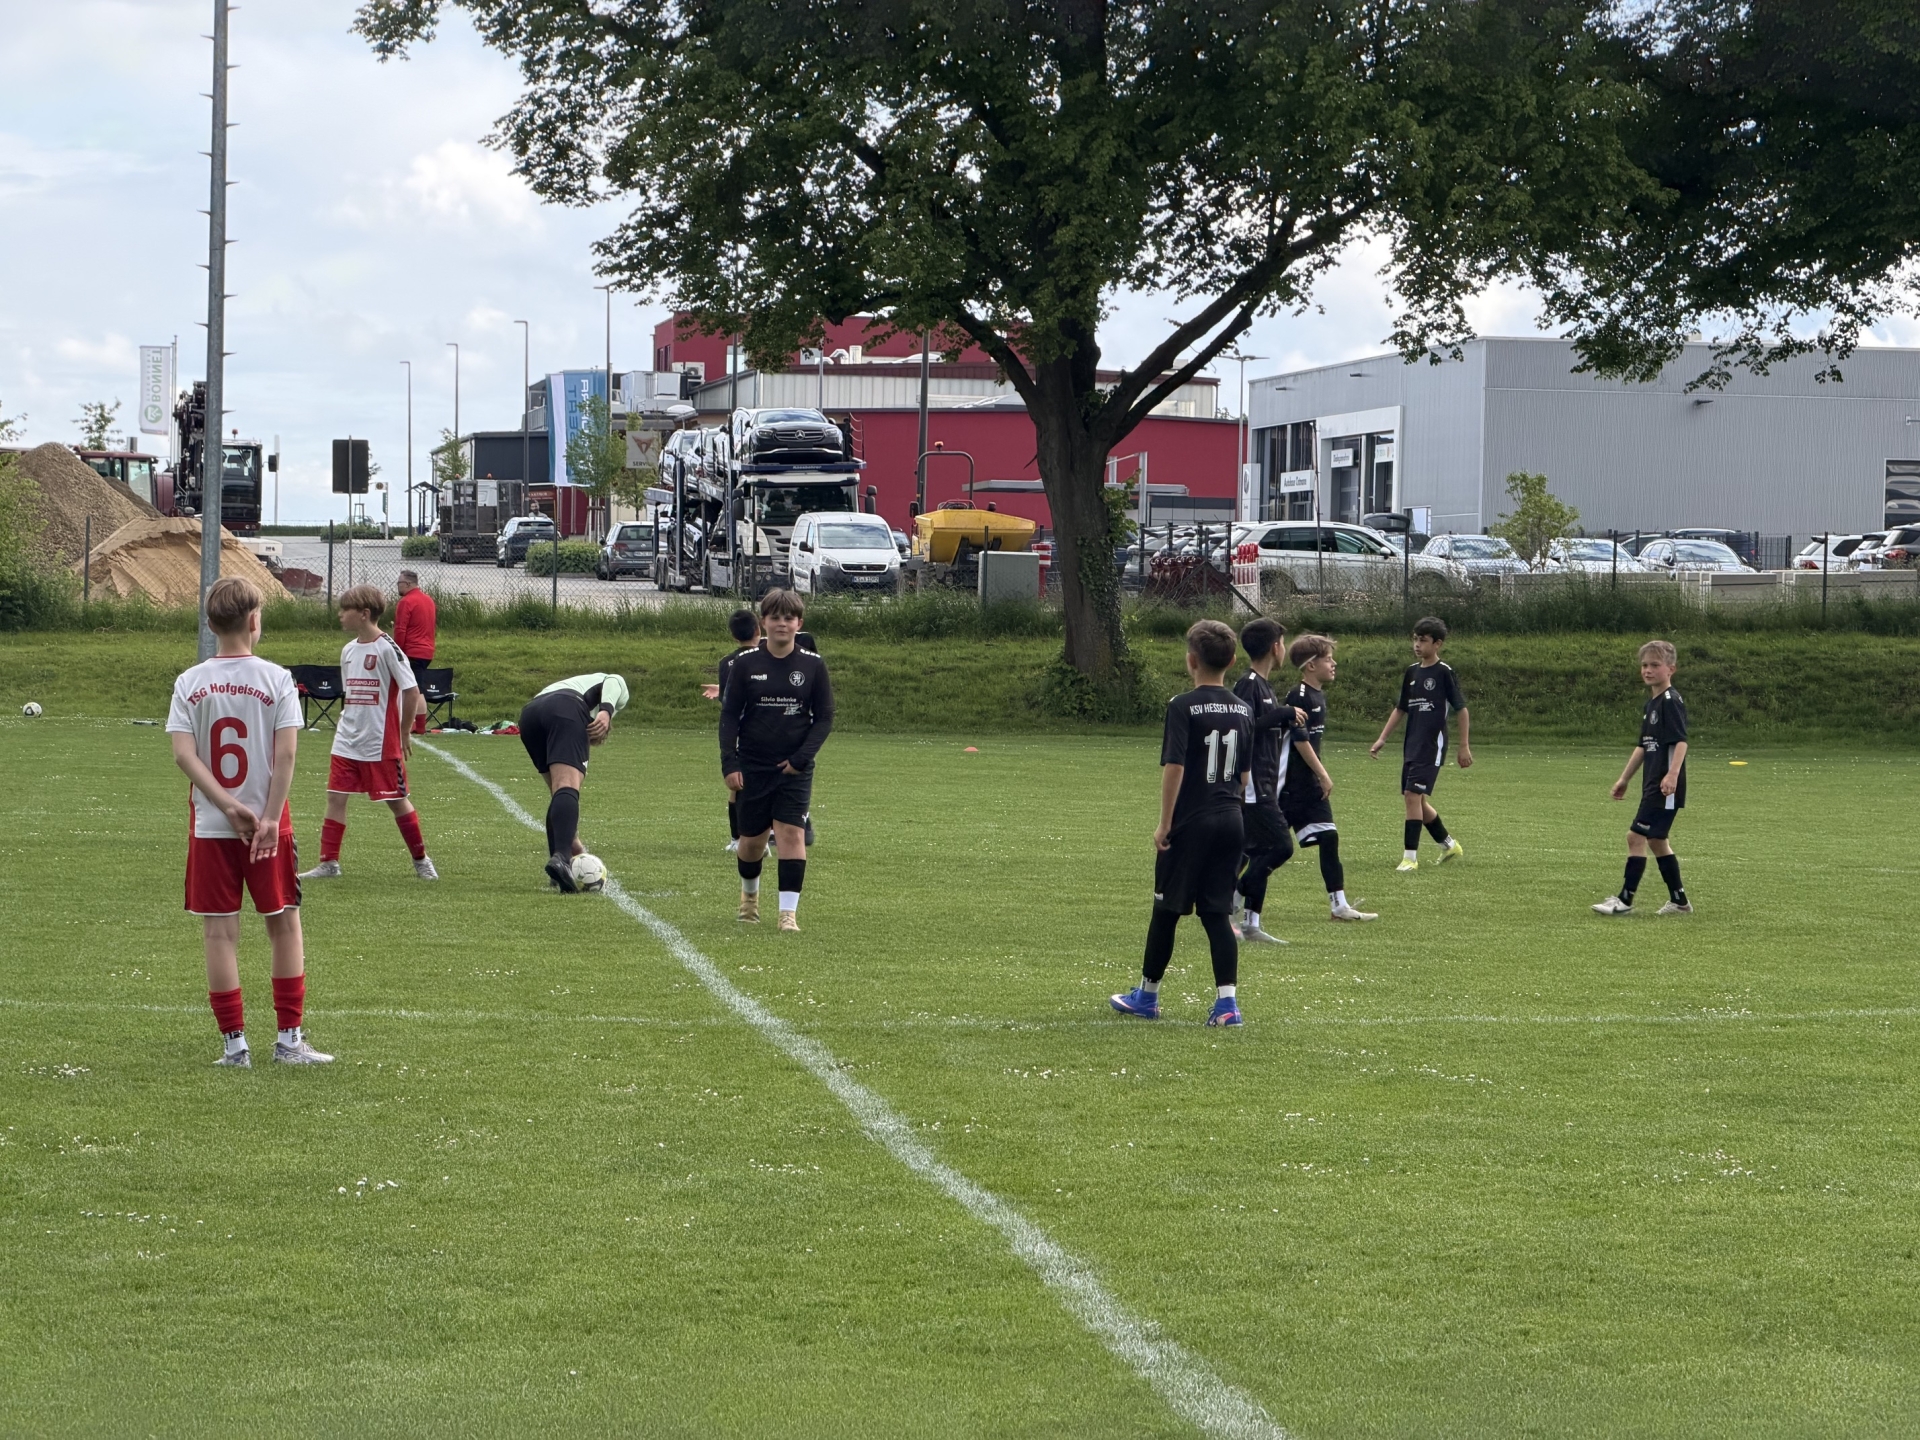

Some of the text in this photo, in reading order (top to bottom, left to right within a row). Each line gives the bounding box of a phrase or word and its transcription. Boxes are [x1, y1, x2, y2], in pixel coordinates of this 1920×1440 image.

[187, 682, 275, 707] TSG Hofgeismar
[1189, 703, 1249, 717] KSV HESSEN KASSEL
[210, 716, 248, 789] 6
[1204, 728, 1238, 783] 11
